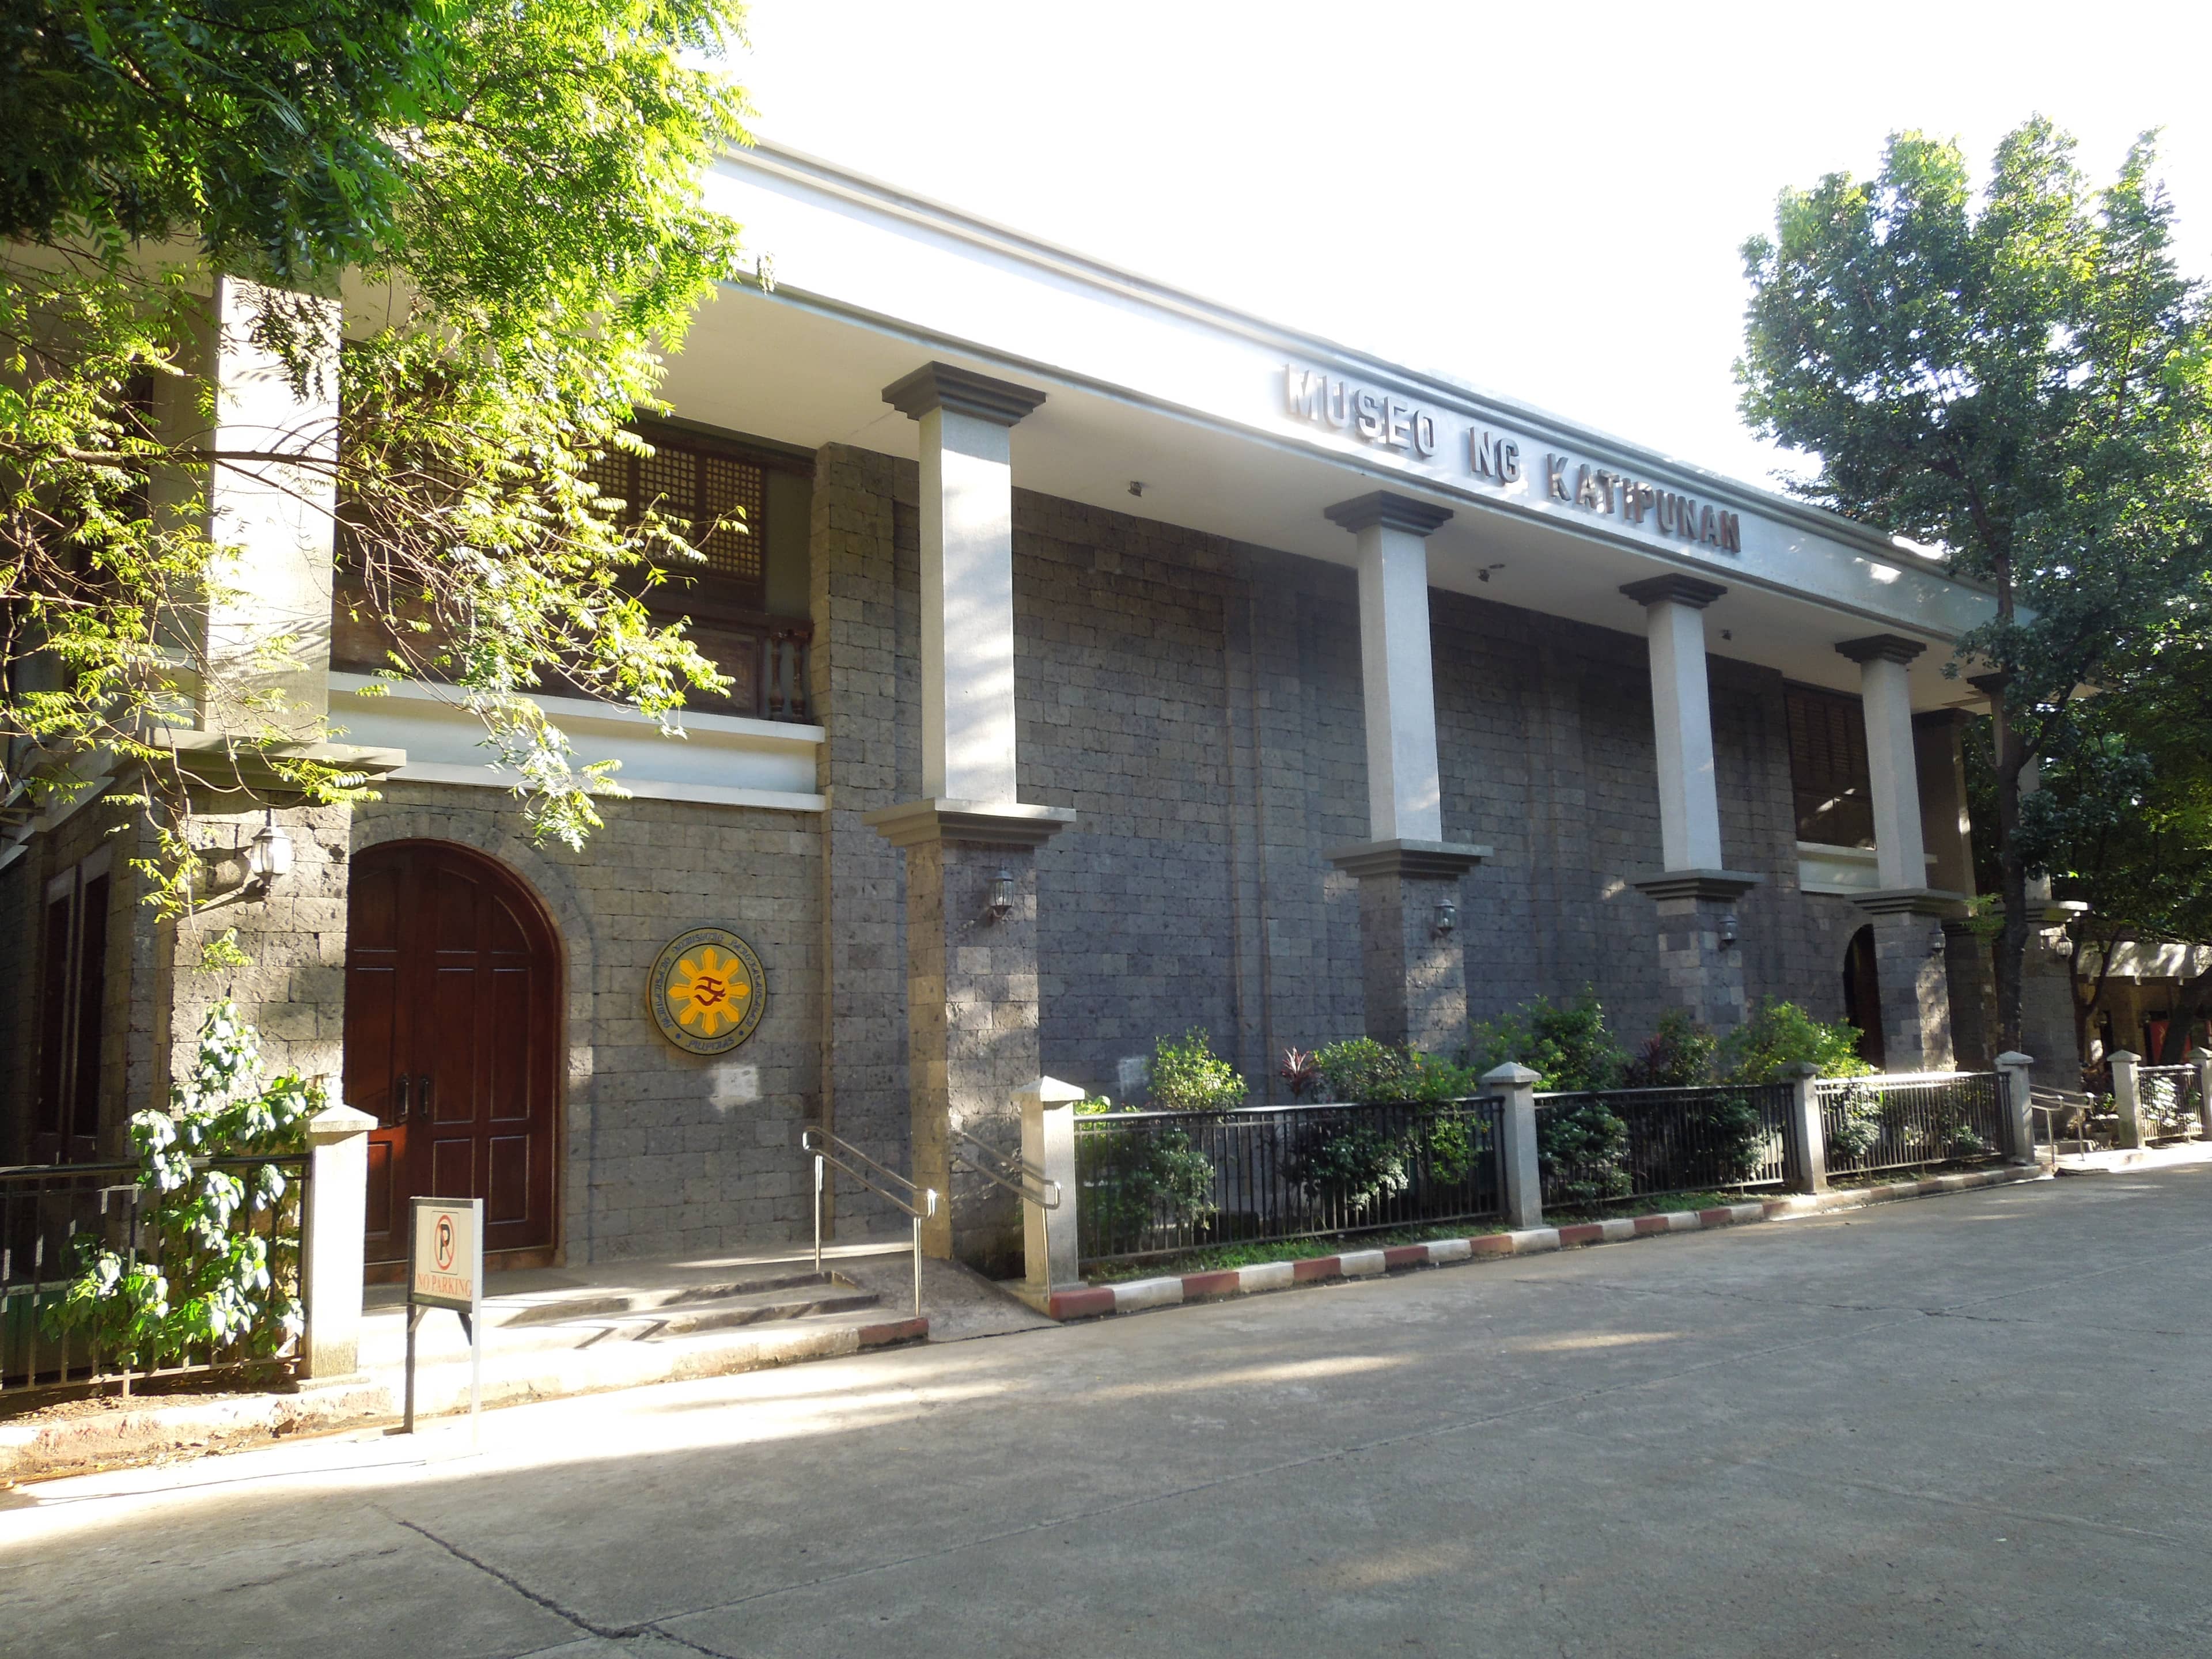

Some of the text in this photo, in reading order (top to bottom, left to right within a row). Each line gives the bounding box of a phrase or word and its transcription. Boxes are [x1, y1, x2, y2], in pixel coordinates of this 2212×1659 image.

[1284, 363, 1742, 554] MUSEO NG KATIPUNAN
[439, 1224, 450, 1260] P
[418, 1274, 472, 1297] NO PARKING
